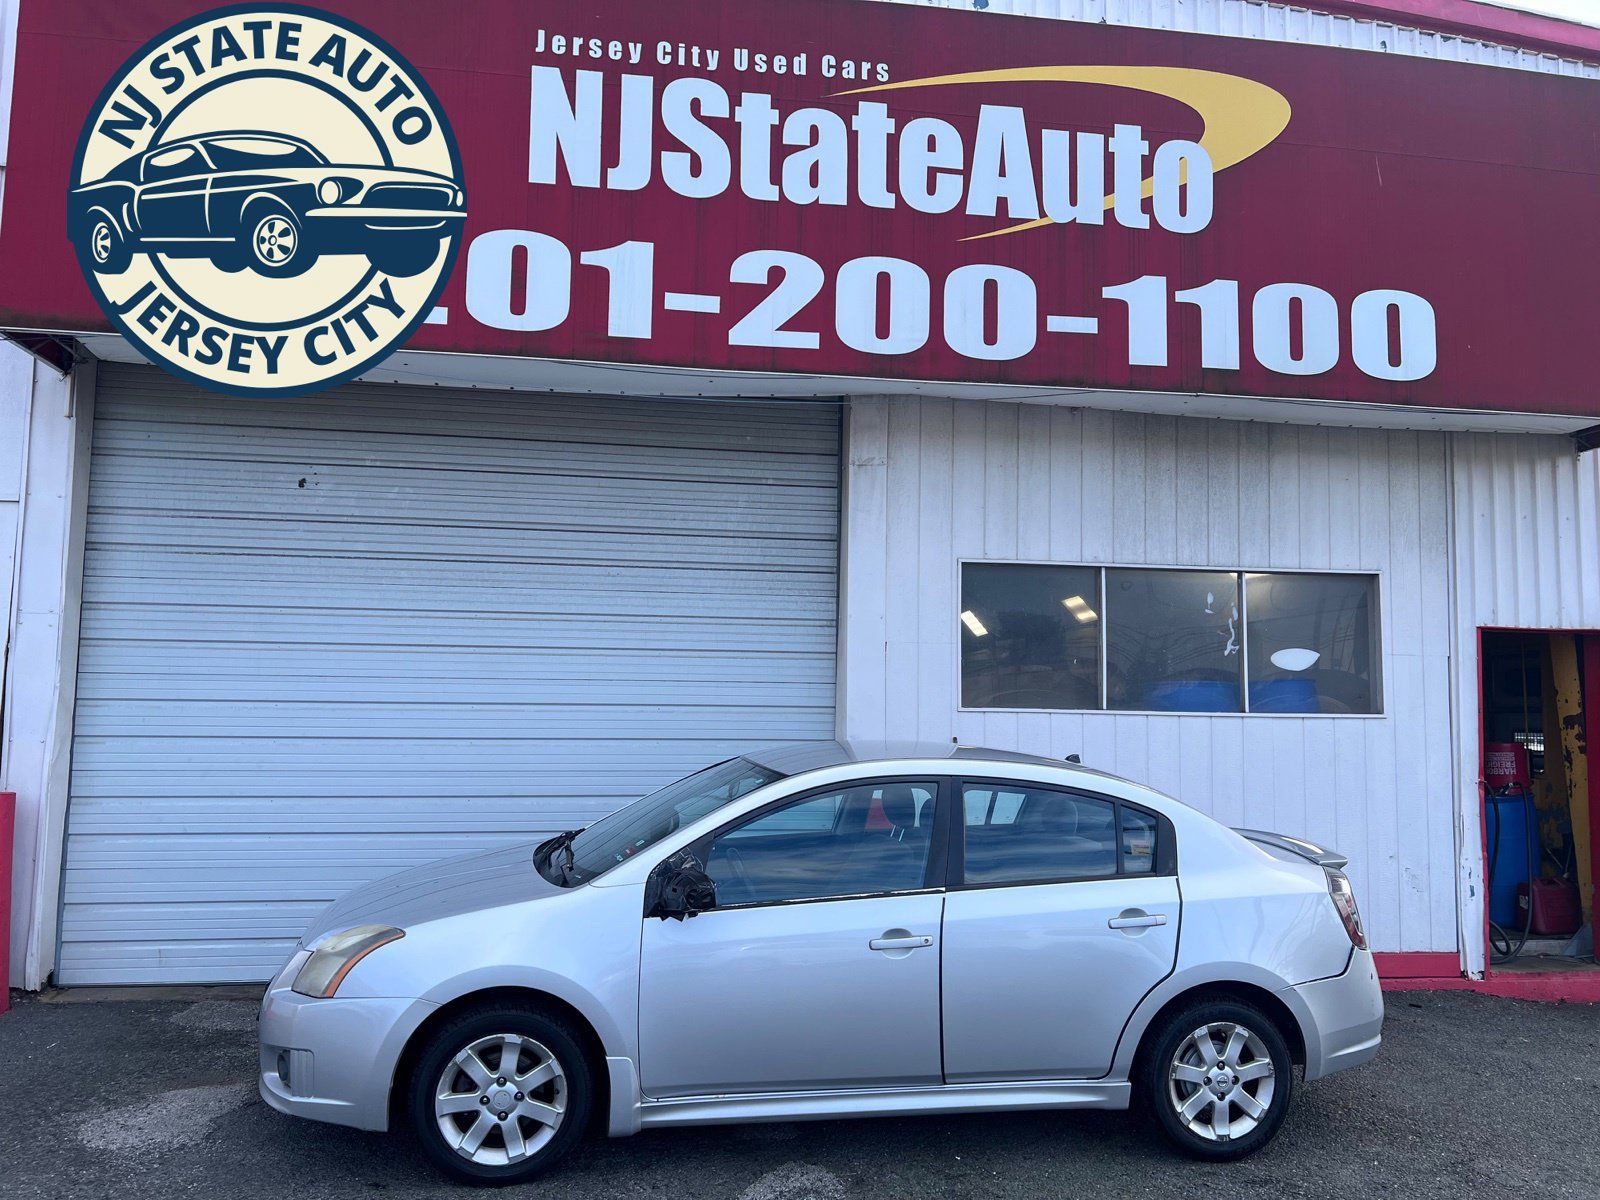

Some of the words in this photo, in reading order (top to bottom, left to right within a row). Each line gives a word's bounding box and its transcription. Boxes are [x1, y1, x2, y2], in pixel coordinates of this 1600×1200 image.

[534, 28, 643, 65] Jersey
[656, 40, 720, 70] City
[733, 47, 807, 76] Used
[821, 54, 890, 83] Cars
[528, 65, 1215, 236] NJStateAuto
[422, 229, 1438, 382] 01-200-1100
